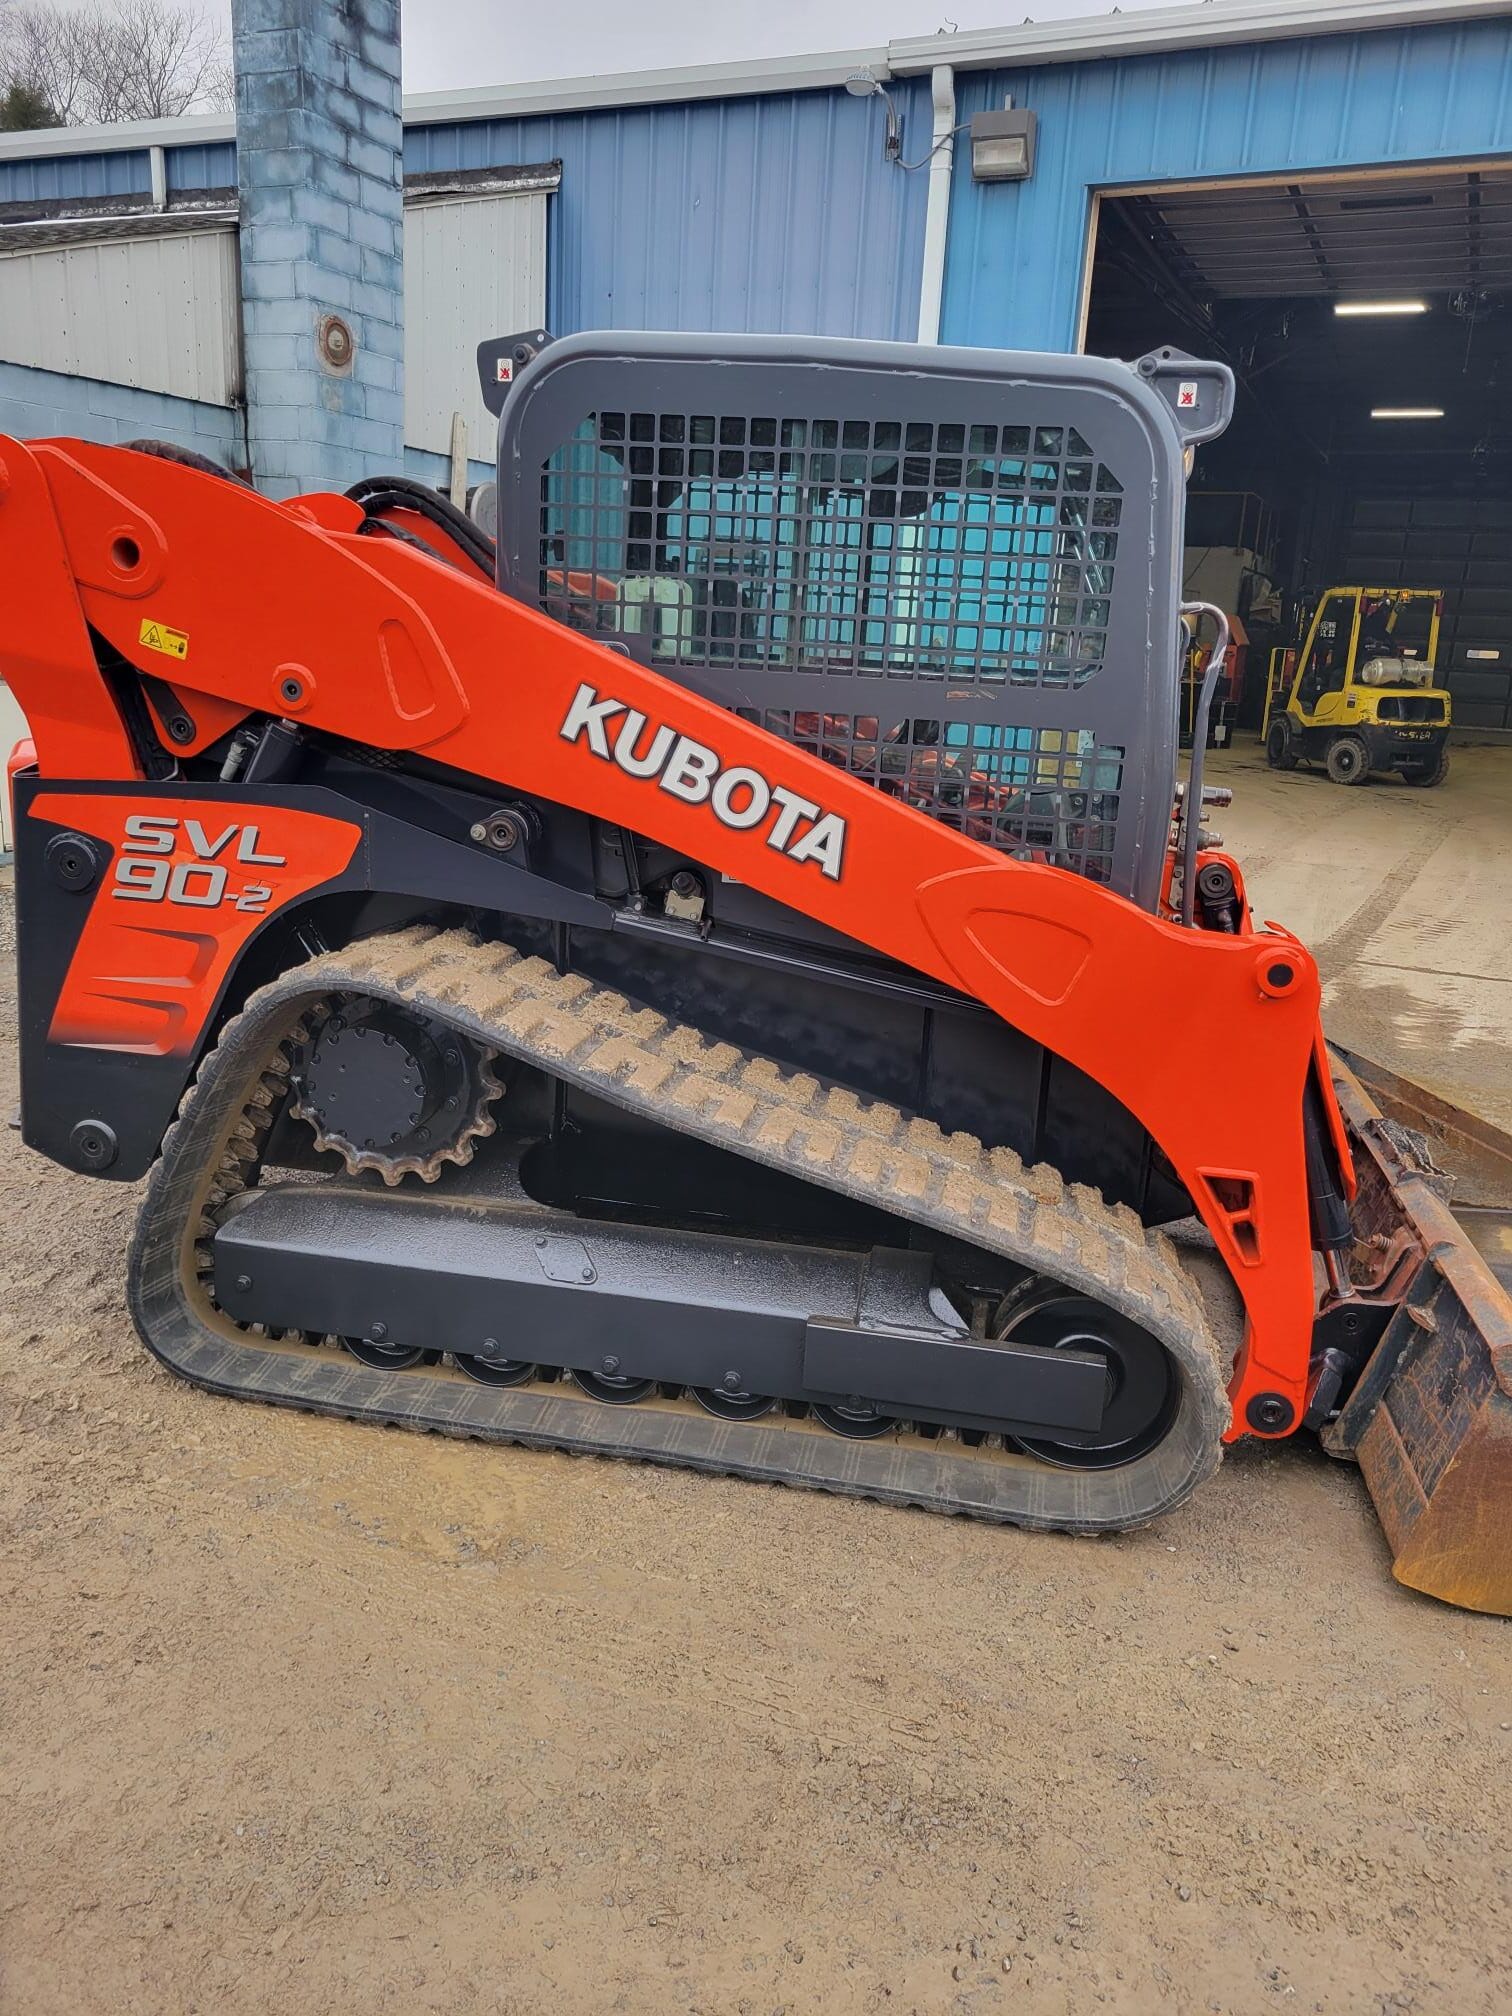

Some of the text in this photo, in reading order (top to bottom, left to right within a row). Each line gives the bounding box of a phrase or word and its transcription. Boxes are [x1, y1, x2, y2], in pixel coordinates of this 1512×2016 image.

[560, 682, 846, 881] KUBOTA
[121, 815, 286, 864] SVL
[111, 857, 272, 913] 90-2
